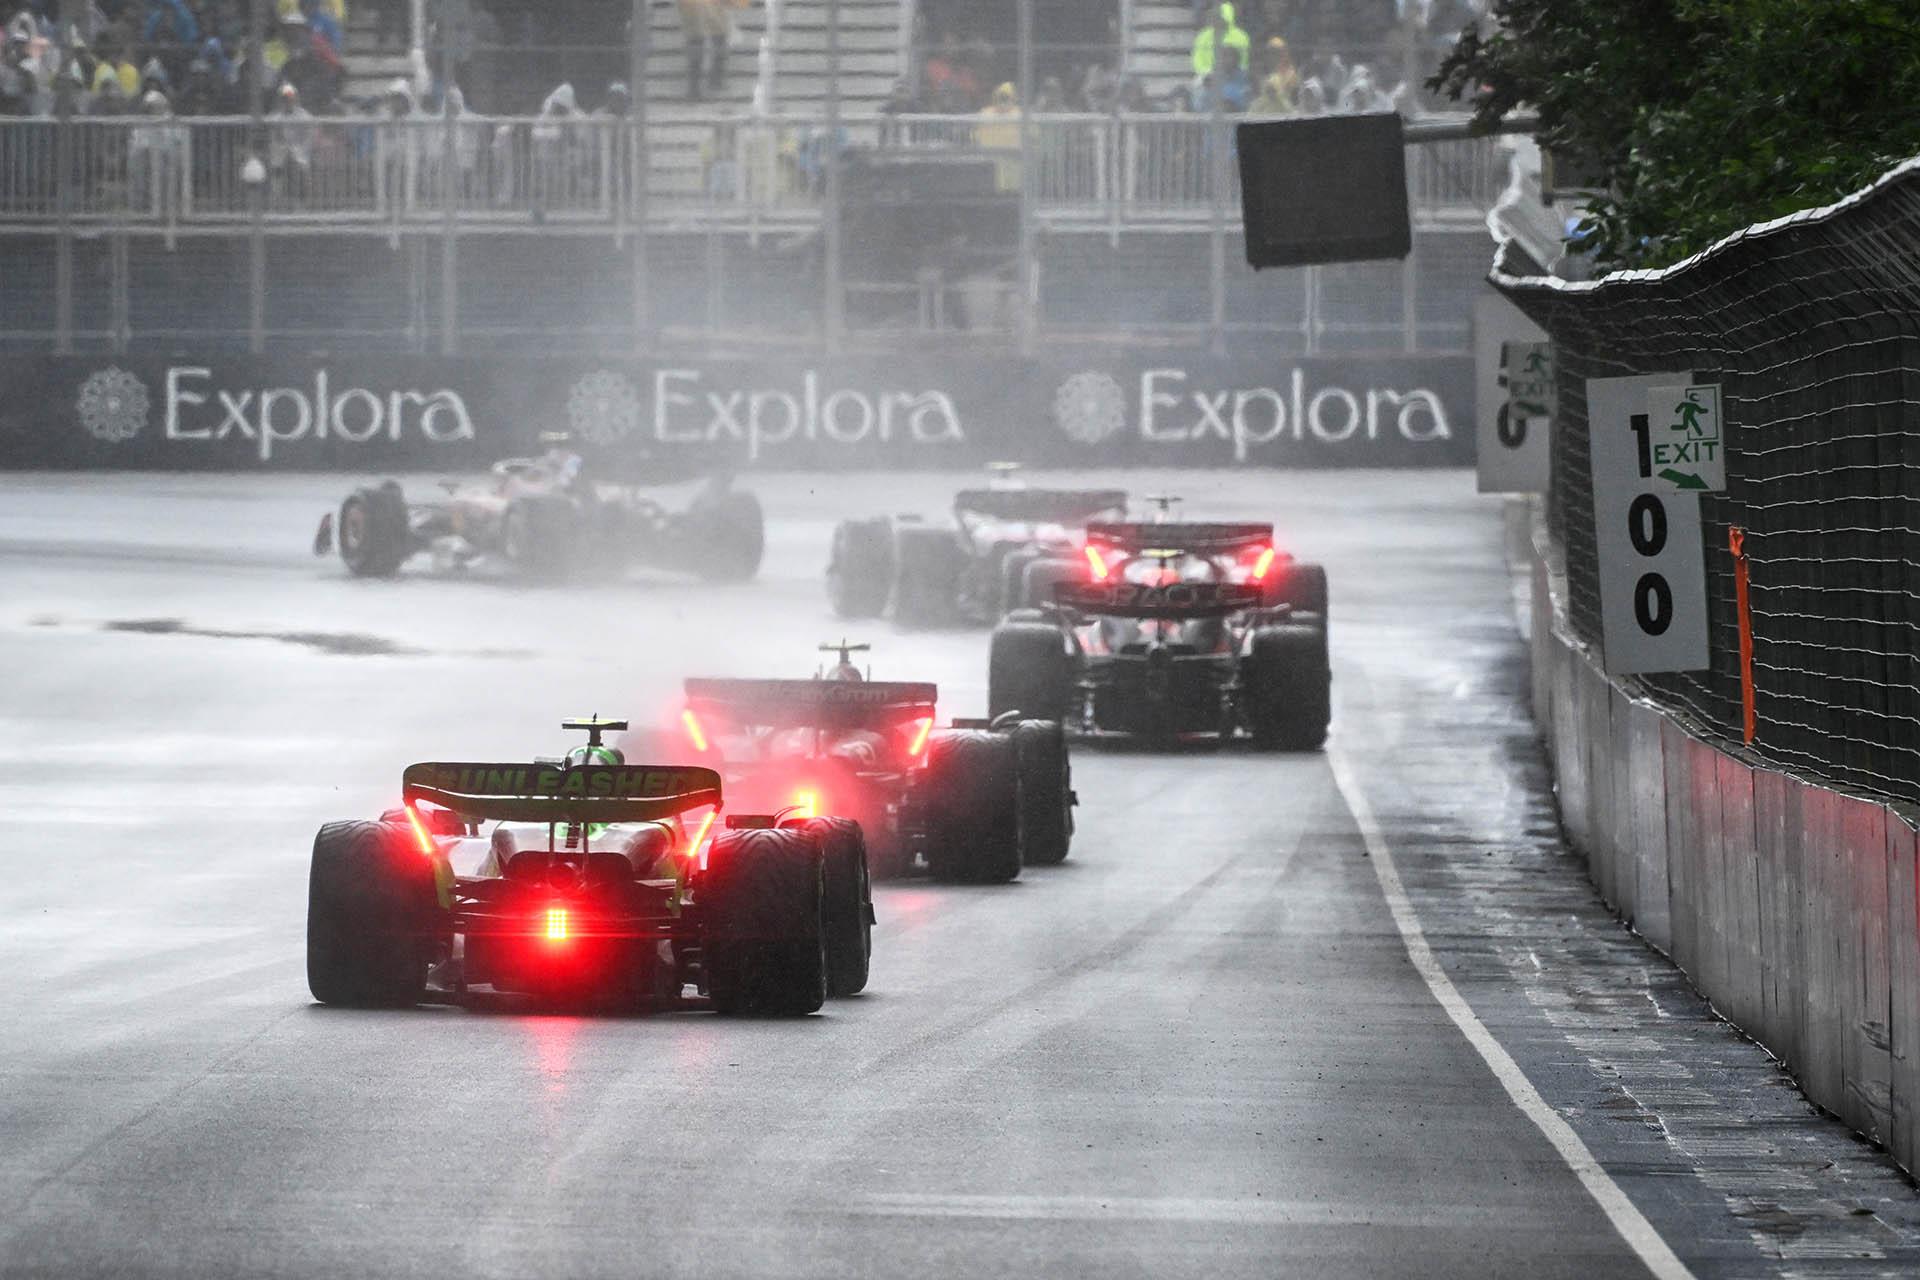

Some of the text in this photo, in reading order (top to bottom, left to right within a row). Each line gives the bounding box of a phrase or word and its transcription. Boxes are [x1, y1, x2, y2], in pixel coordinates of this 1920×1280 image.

[166, 367, 475, 460] Explora
[655, 369, 965, 459] Explora
[1139, 368, 1449, 461] Explora
[1654, 441, 1720, 465] EXIT
